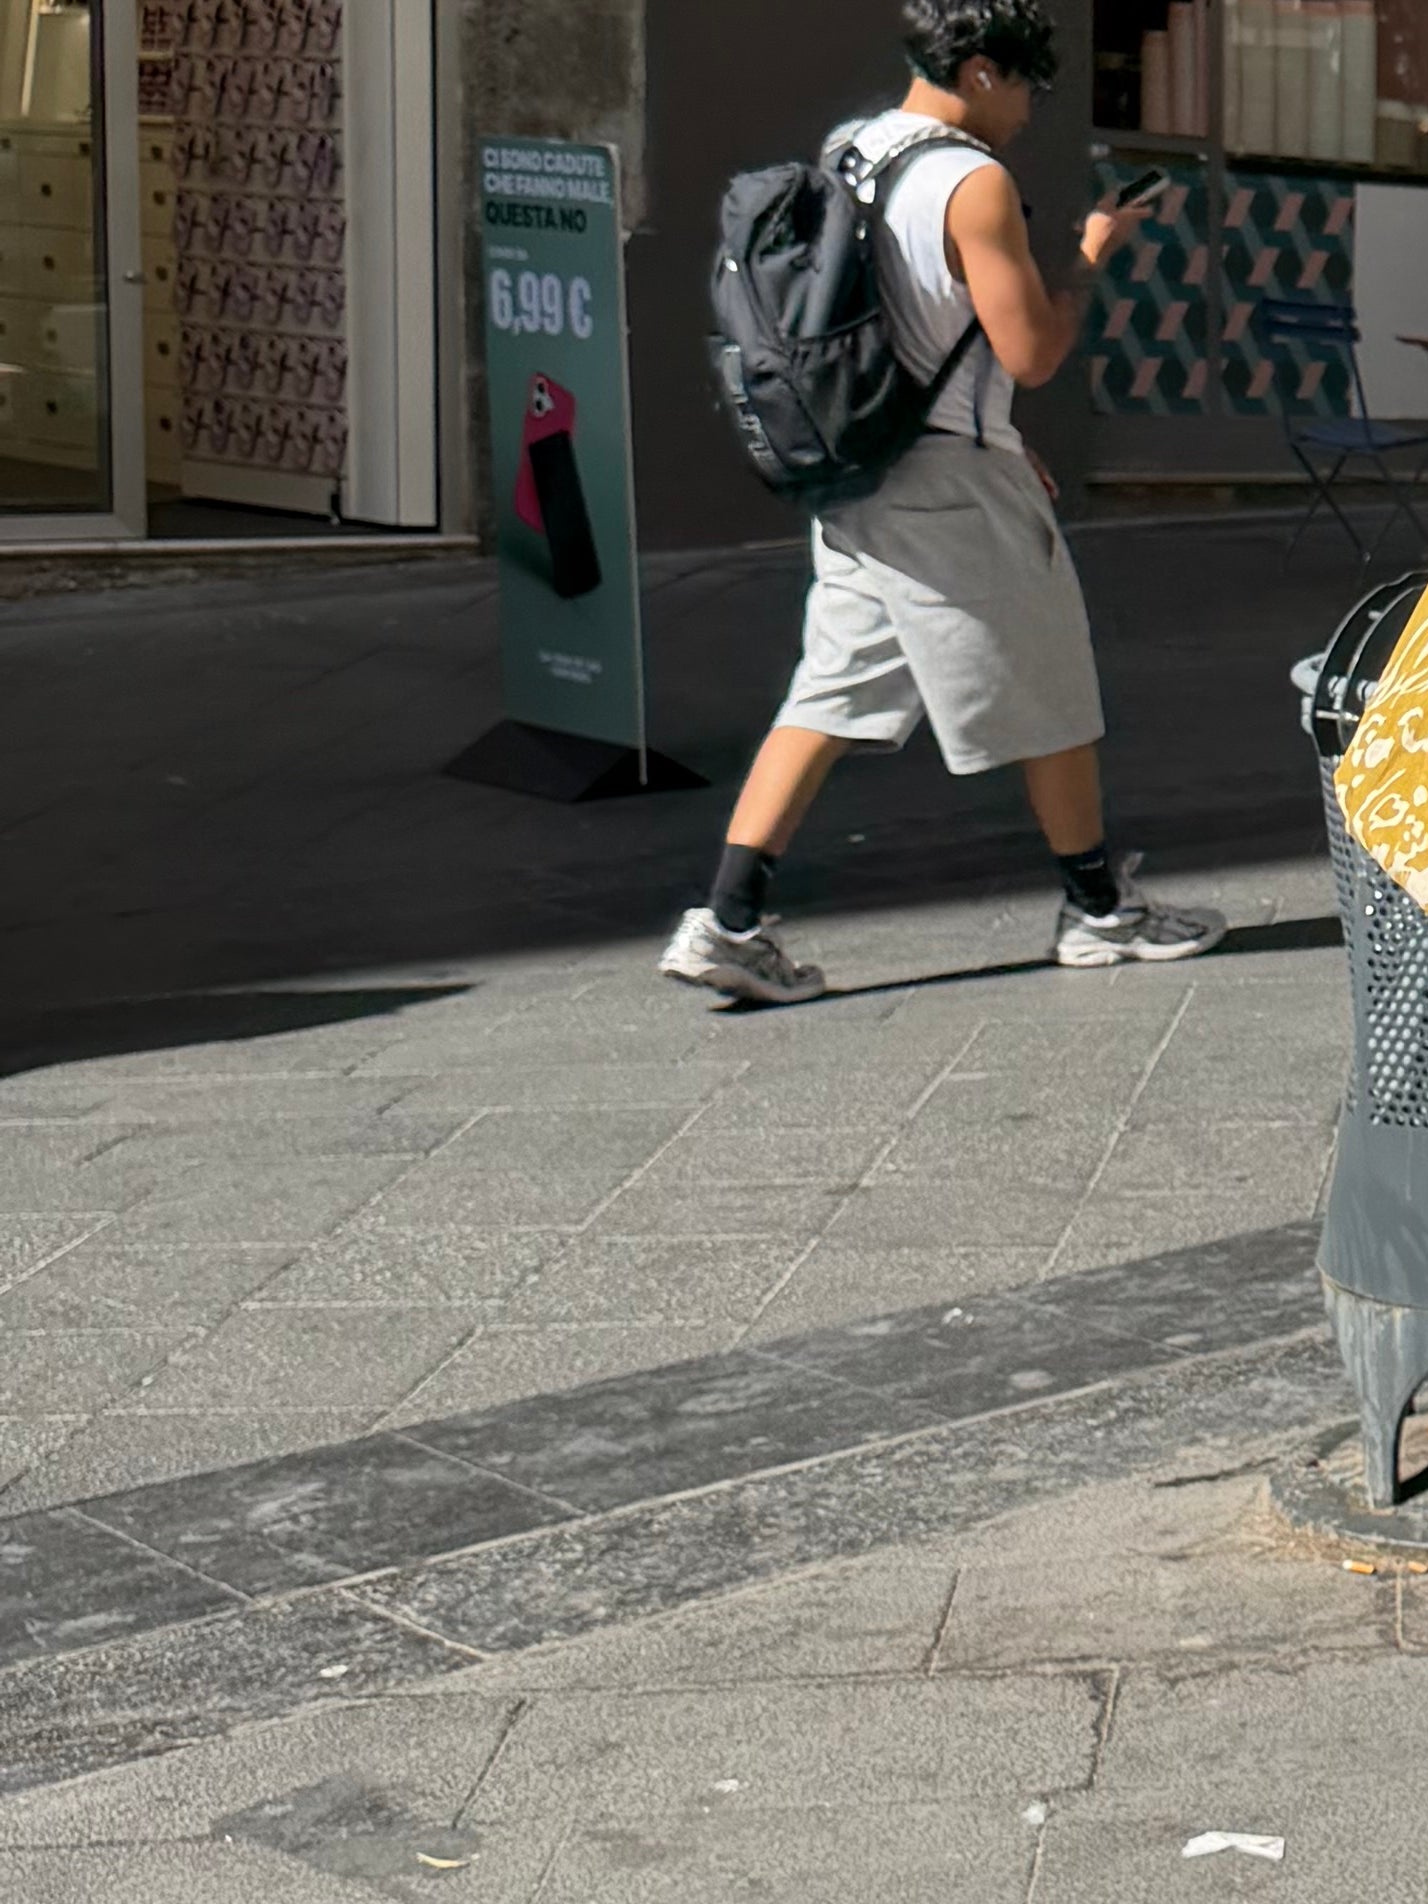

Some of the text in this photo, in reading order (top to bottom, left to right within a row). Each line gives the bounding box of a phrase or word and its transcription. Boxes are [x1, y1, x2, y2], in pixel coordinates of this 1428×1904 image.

[543, 151, 606, 178] CADUTE
[515, 174, 567, 200] FANNO
[485, 201, 588, 234] QUESTA NO
[490, 267, 565, 336] 6,99
